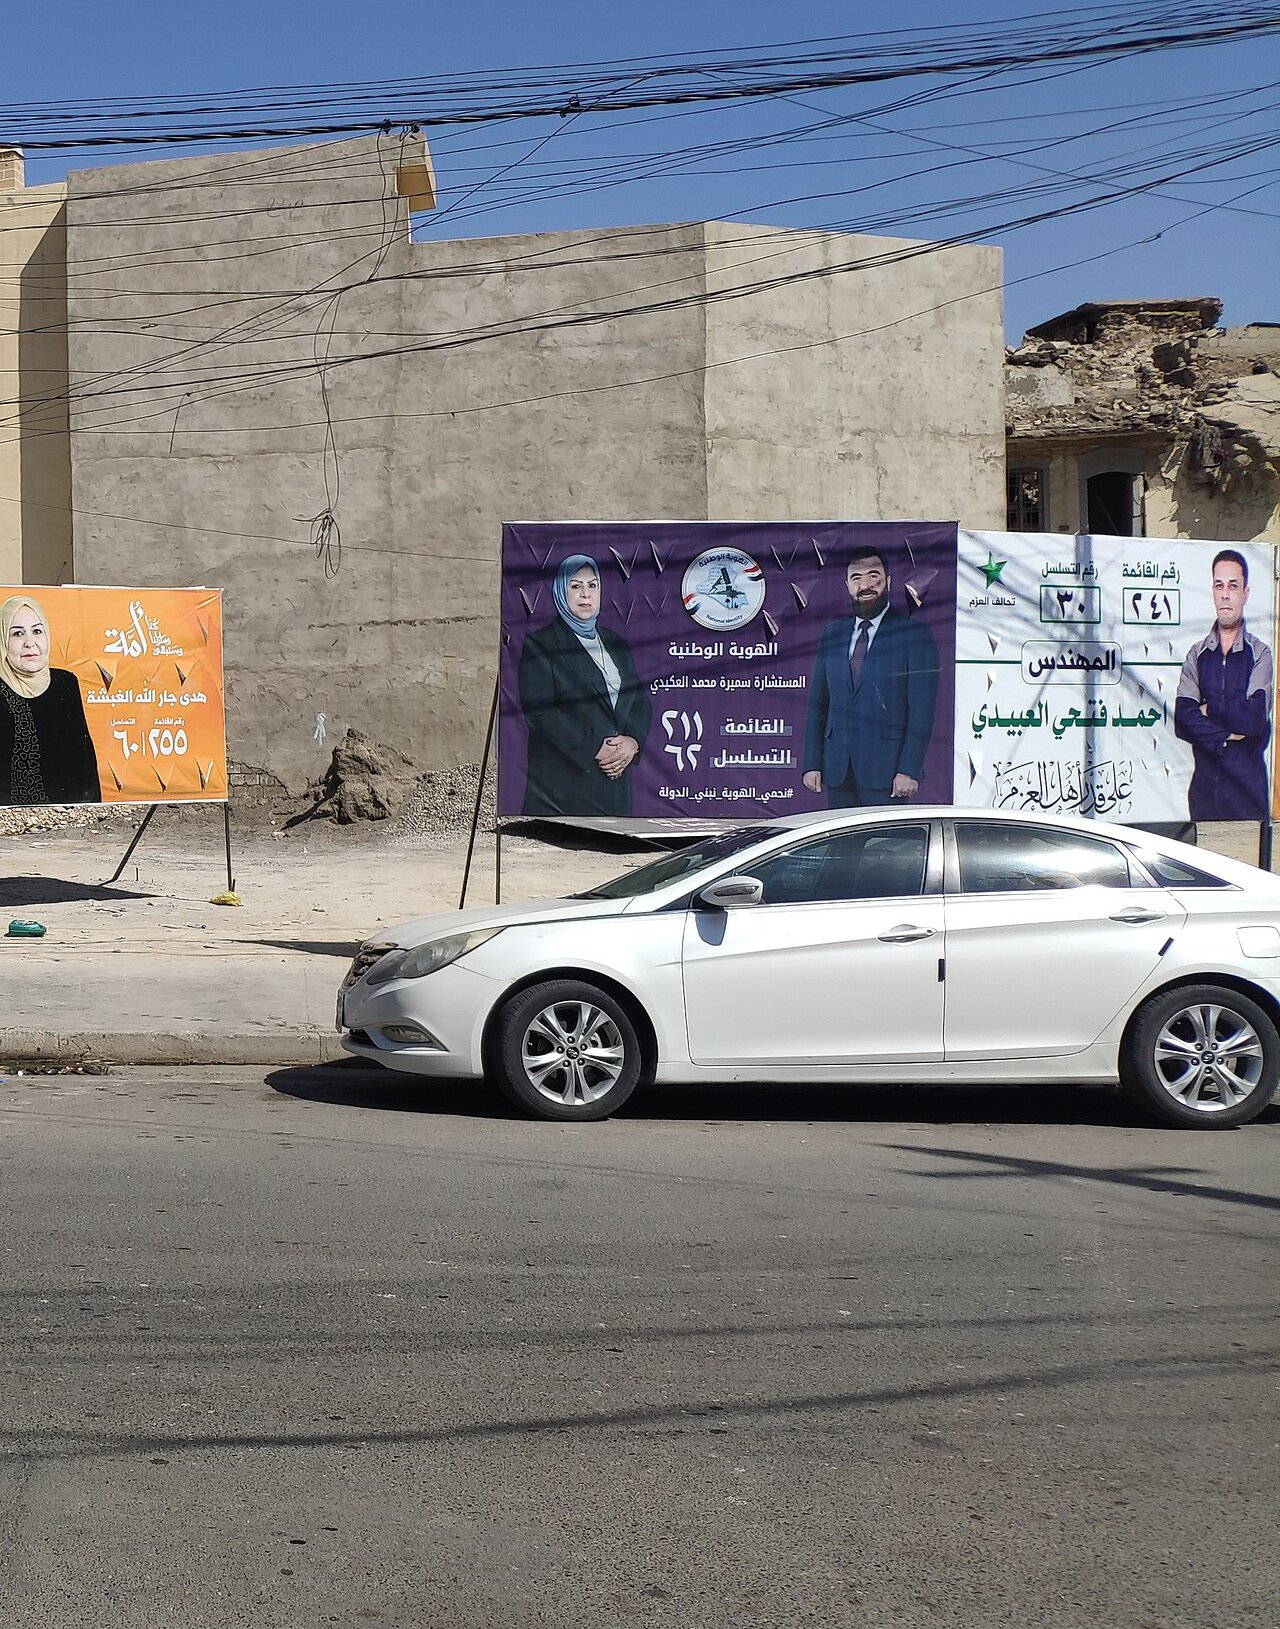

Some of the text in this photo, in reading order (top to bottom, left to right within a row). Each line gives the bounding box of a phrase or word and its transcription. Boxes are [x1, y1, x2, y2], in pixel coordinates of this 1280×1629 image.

[1041, 560, 1099, 581] رقم التسلسل
[1122, 561, 1181, 585] رقم القائمة
[968, 596, 1016, 608] تحالف العزم
[1056, 589, 1086, 619] ٣٠
[1131, 592, 1173, 621] ٢٤١
[668, 641, 778, 660] الهوية الوطنية
[1028, 648, 1116, 678] المهندس
[135, 681, 156, 704] الله
[650, 674, 807, 695] المستشارة سميرة محمد العكيدي
[158, 689, 178, 708] جار
[179, 690, 207, 706] هدى
[661, 709, 785, 741] القائمة ٢١١
[971, 698, 1168, 741] احمد فتحي العبيدي
[112, 728, 140, 760] ٦٠
[147, 728, 188, 760] ٢٥٥
[663, 743, 792, 772] التسلسل ٦٢
